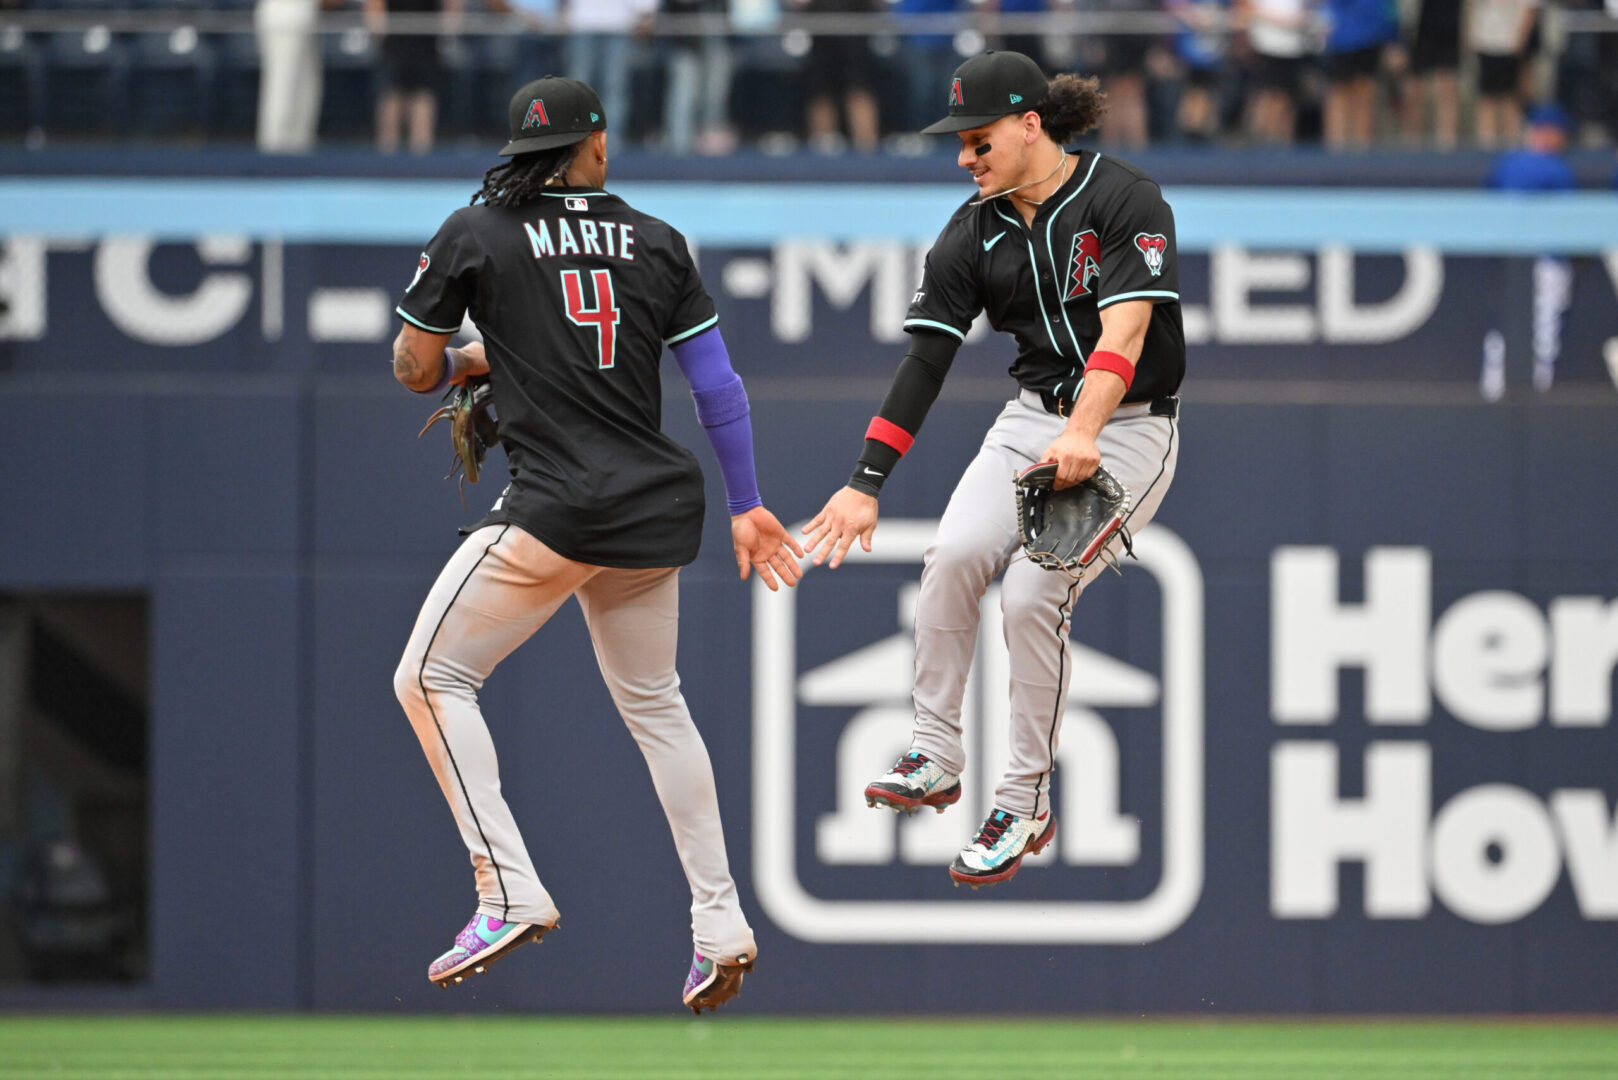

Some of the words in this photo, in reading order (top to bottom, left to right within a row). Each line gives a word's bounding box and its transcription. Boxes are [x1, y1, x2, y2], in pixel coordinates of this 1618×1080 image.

[521, 98, 551, 130] A
[523, 217, 635, 261] MARTE
[560, 269, 621, 369] 4
